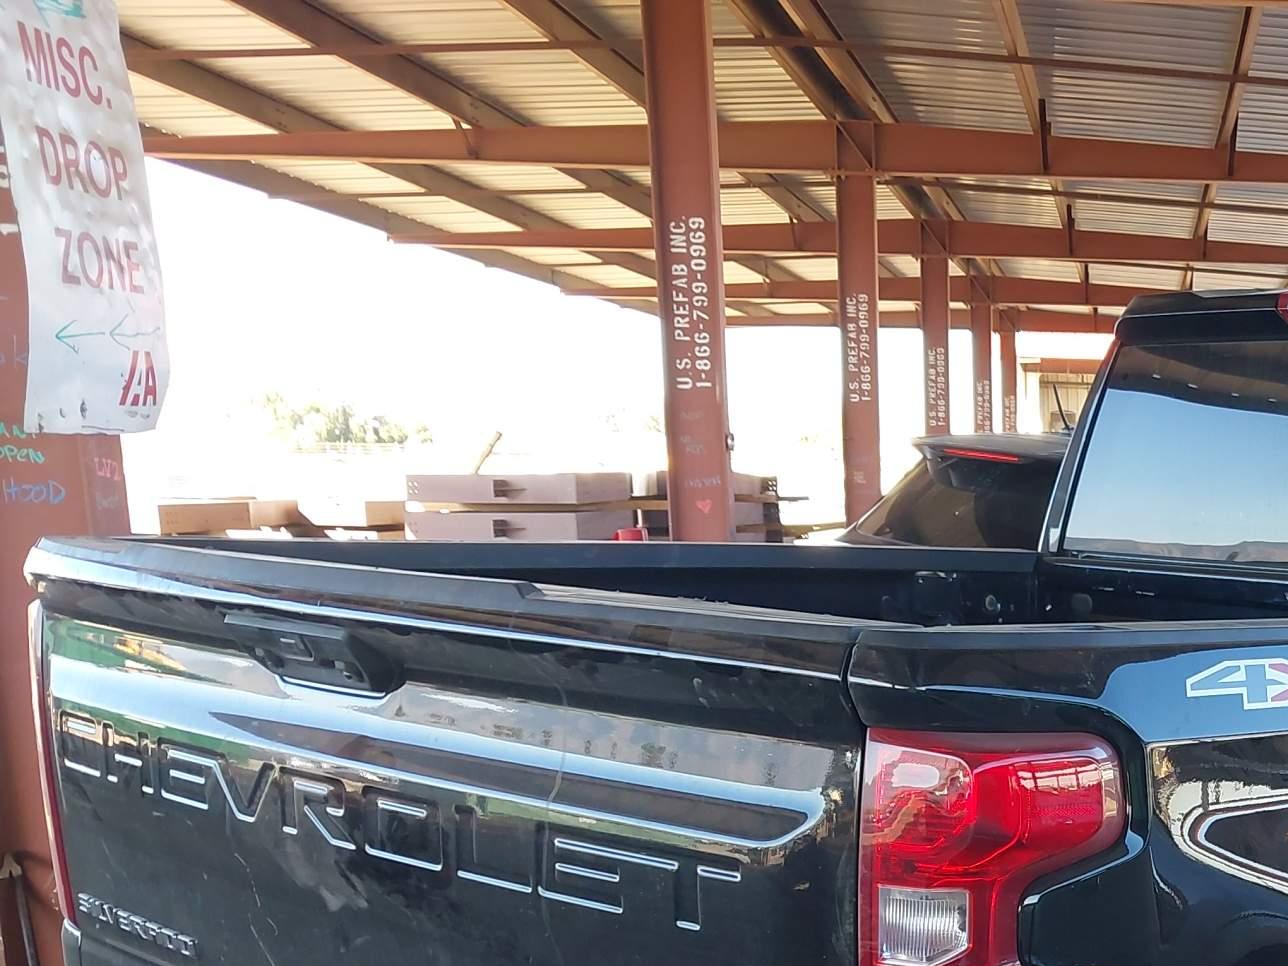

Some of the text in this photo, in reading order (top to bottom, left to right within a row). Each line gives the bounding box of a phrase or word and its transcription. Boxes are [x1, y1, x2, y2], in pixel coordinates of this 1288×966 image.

[16, 20, 113, 110] MISC.
[35, 125, 128, 201] DROP
[54, 227, 145, 295] ZONE
[669, 215, 693, 390] U.S. PREFAB INC.
[689, 216, 712, 388] 1-866-799-0969
[847, 323, 859, 372] PREFAB
[58, 709, 748, 933] CHEVROLET
